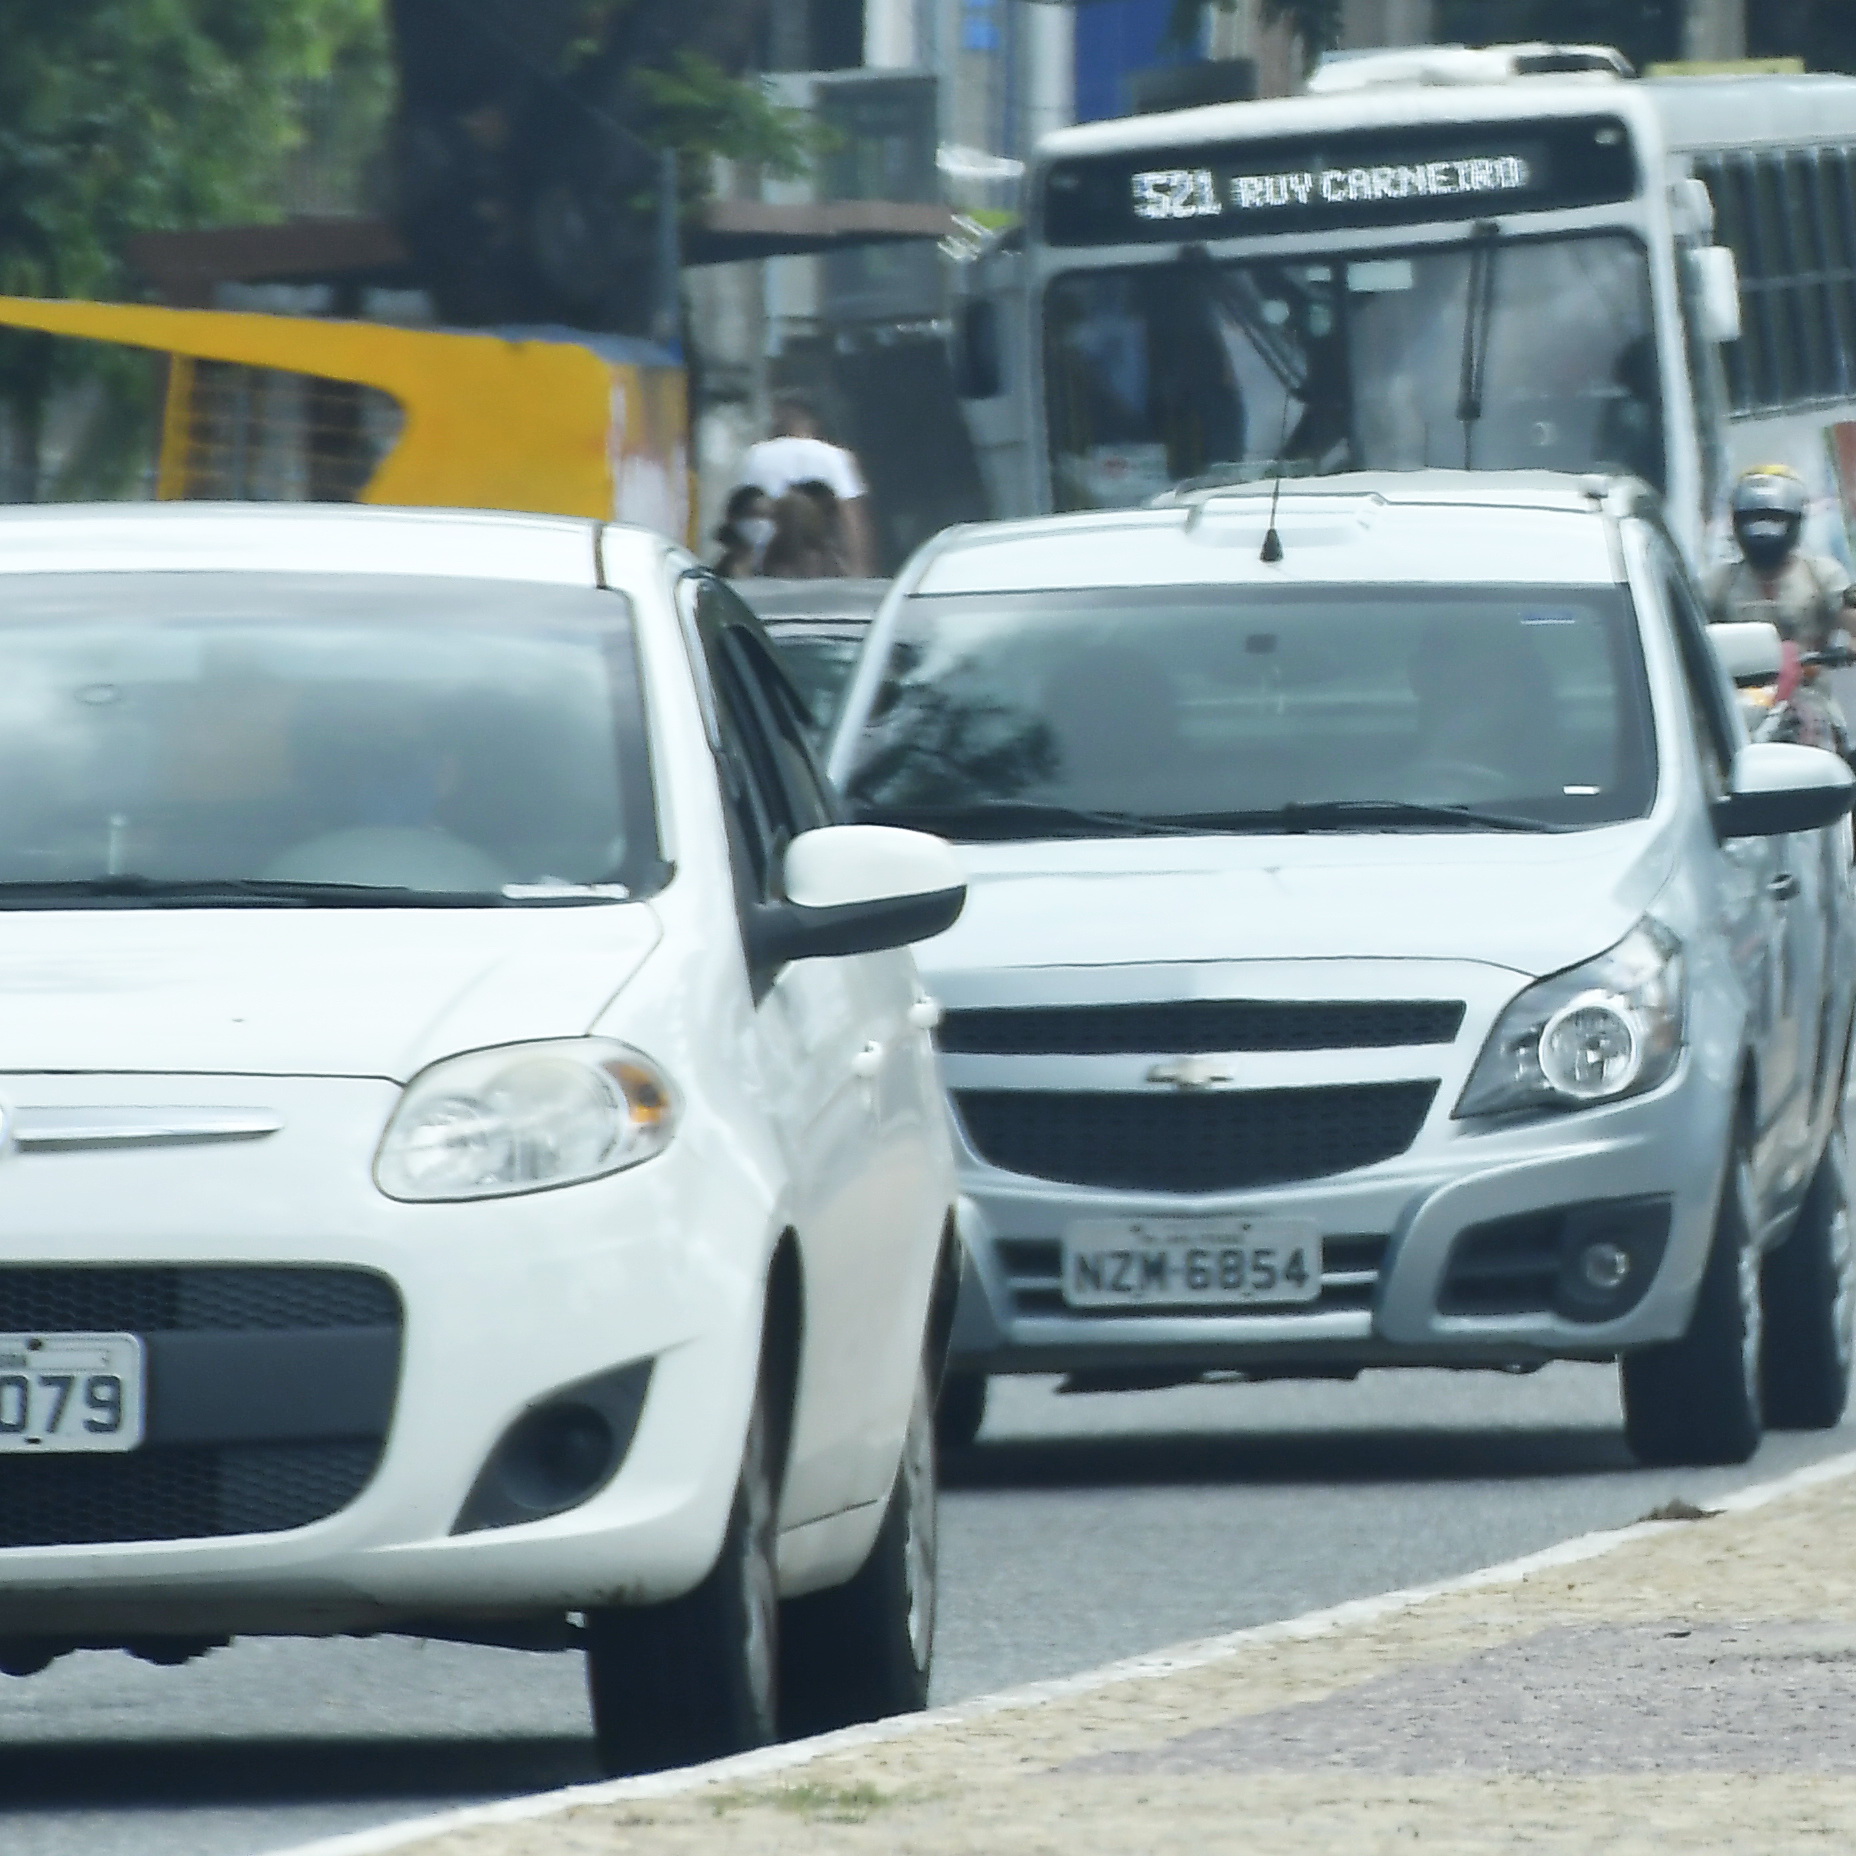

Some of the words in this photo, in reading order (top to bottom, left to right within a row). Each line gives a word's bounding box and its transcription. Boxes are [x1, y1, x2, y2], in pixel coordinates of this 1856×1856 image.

[1132, 167, 1222, 220] 521
[1231, 171, 1313, 209] RUY
[1322, 155, 1528, 203] CARNEIRO
